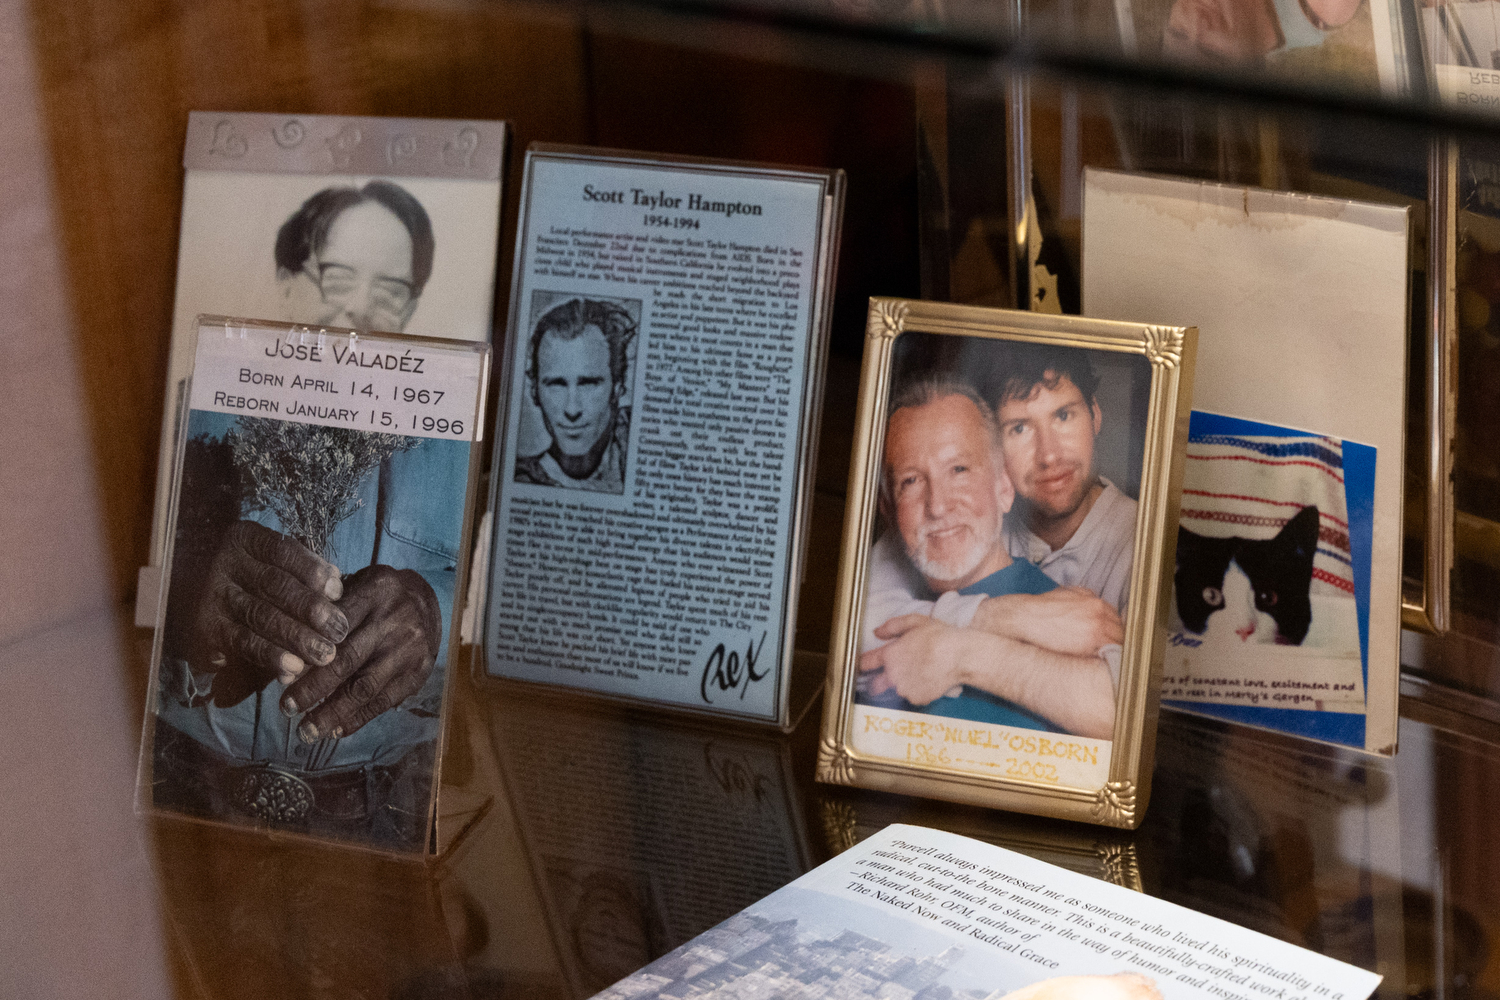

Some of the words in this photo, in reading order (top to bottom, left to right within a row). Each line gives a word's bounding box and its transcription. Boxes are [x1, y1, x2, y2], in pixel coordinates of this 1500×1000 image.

[583, 184, 624, 204] Scott
[630, 188, 682, 210] Taylor
[687, 193, 763, 217] Hampton
[643, 214, 700, 230] 1954-1994
[331, 342, 425, 375] VALADÉZ
[238, 367, 285, 387] BORN
[290, 374, 339, 394] APRIL
[350, 381, 379, 400] 14,
[392, 385, 445, 406] 1967
[213, 390, 280, 413] REBORN
[285, 400, 359, 422] JANUARY
[369, 409, 399, 429] 15,
[411, 414, 464, 436] 1996
[1333, 683, 1355, 691] and
[864, 714, 932, 740] ROGER
[1009, 734, 1098, 765] OSBORN
[1006, 758, 1059, 782] 2002
[846, 881, 871, 895] The
[870, 890, 914, 910] Naked
[911, 905, 939, 920] Now
[940, 919, 971, 932] and
[968, 927, 1020, 953] Radical
[1018, 948, 1059, 969] Grace
[850, 871, 910, 892] —Richard
[905, 887, 938, 904] Rohr,
[940, 900, 975, 919] OFM,
[975, 916, 1021, 935] author
[1019, 933, 1039, 941] of
[866, 861, 896, 873] man
[894, 869, 924, 882] who
[923, 877, 953, 892] had
[949, 888, 987, 906] much
[987, 902, 1003, 912] to
[1002, 908, 1040, 926] share
[1039, 922, 1057, 932] in
[1056, 928, 1081, 941] the
[1080, 937, 1111, 954] way
[1110, 949, 1132, 959] of
[1127, 953, 1175, 976] humor
[1175, 974, 1209, 989] and
[871, 849, 917, 865] radical,
[917, 862, 976, 885] cut-to-the
[975, 880, 1009, 897] bone
[1008, 893, 1061, 916] manner.
[1064, 912, 1095, 929] This
[1095, 925, 1109, 934] is
[1108, 930, 1122, 939] a
[1121, 933, 1250, 985] beautifully-crafted
[1248, 981, 1286, 1000] work
[891, 840, 938, 856] "Purcell
[933, 852, 978, 870] always
[978, 867, 1046, 893] impressed
[1042, 889, 1065, 900] me
[1063, 897, 1081, 906] as
[1081, 903, 1140, 926] someone
[1139, 922, 1171, 938] who
[1171, 932, 1209, 951] lived
[1206, 944, 1231, 959] his
[1231, 955, 1311, 990] spirituality
[1312, 984, 1331, 996] in
[1331, 992, 1344, 1000] a
